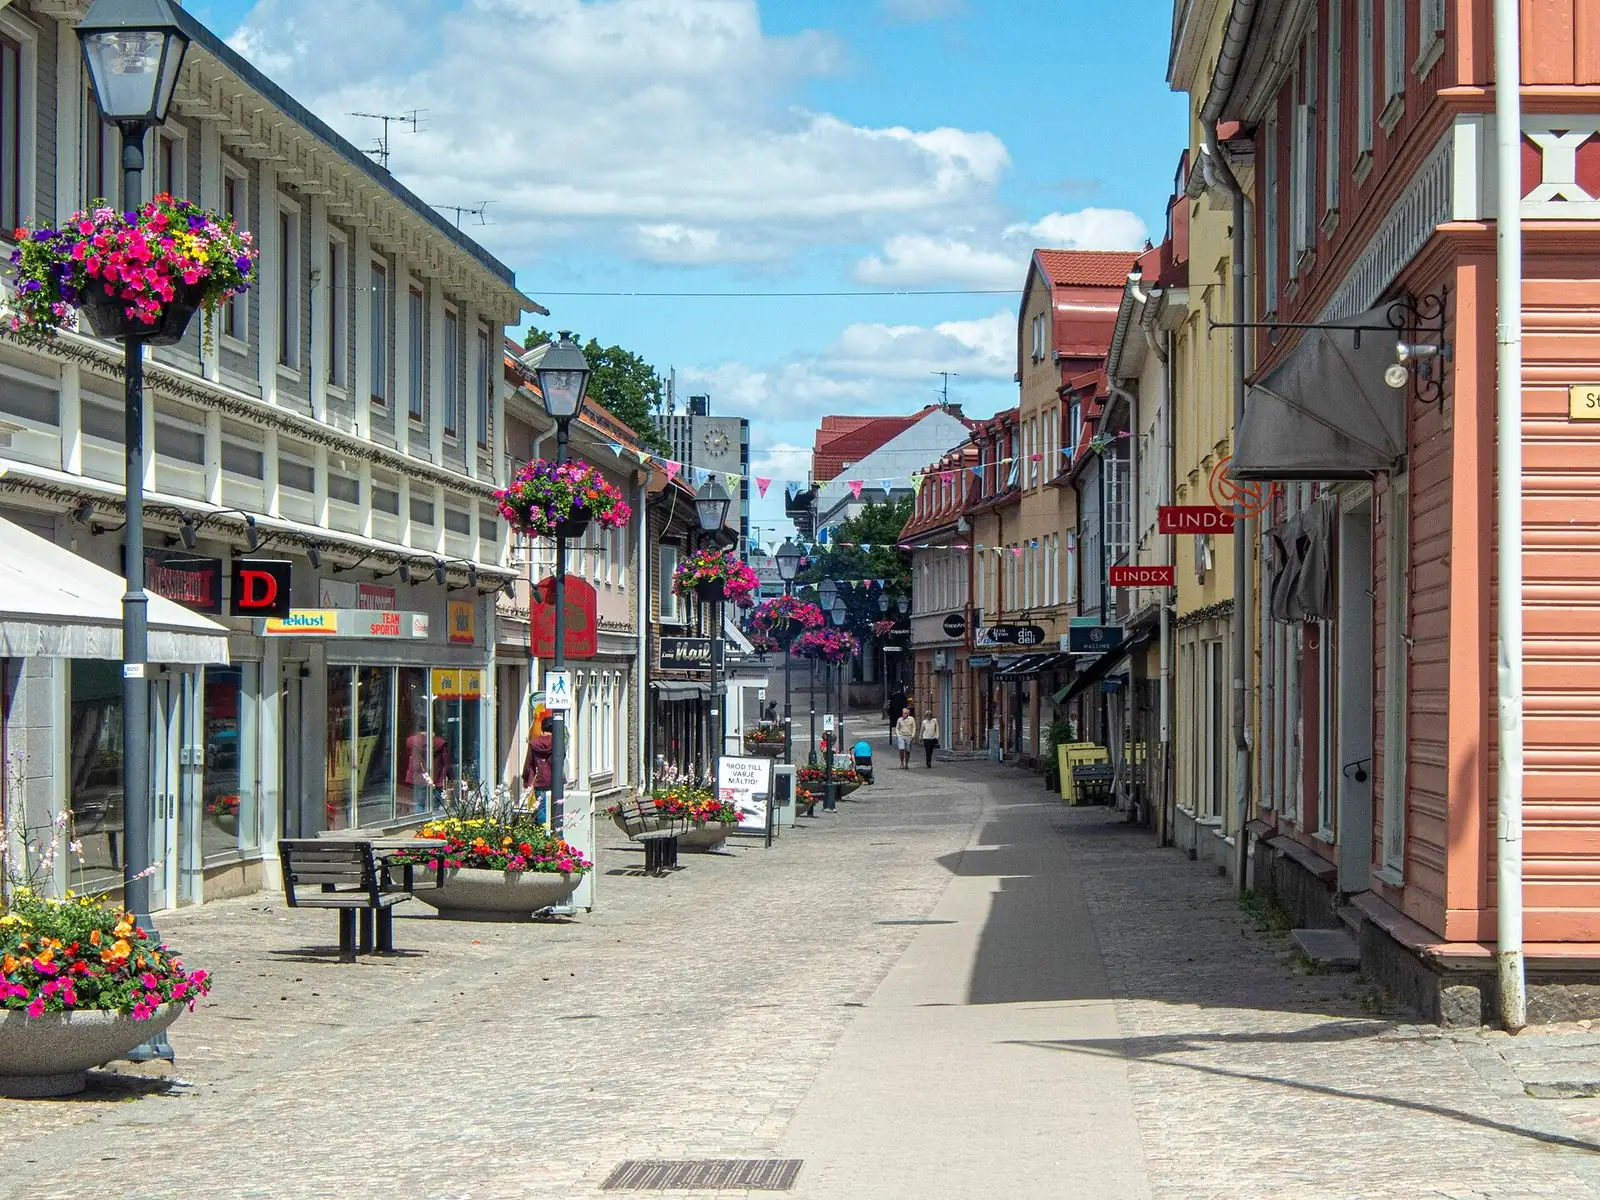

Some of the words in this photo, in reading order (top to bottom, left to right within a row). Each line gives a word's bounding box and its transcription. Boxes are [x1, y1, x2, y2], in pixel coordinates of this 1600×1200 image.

[1167, 512, 1234, 528] LINDE
[1115, 570, 1169, 582] LINDEX
[283, 614, 324, 626] eklust
[382, 612, 400, 624] TEAM
[1018, 627, 1033, 637] din
[1018, 633, 1036, 644] deli
[676, 641, 711, 661] Nail
[549, 697, 554, 705] 2
